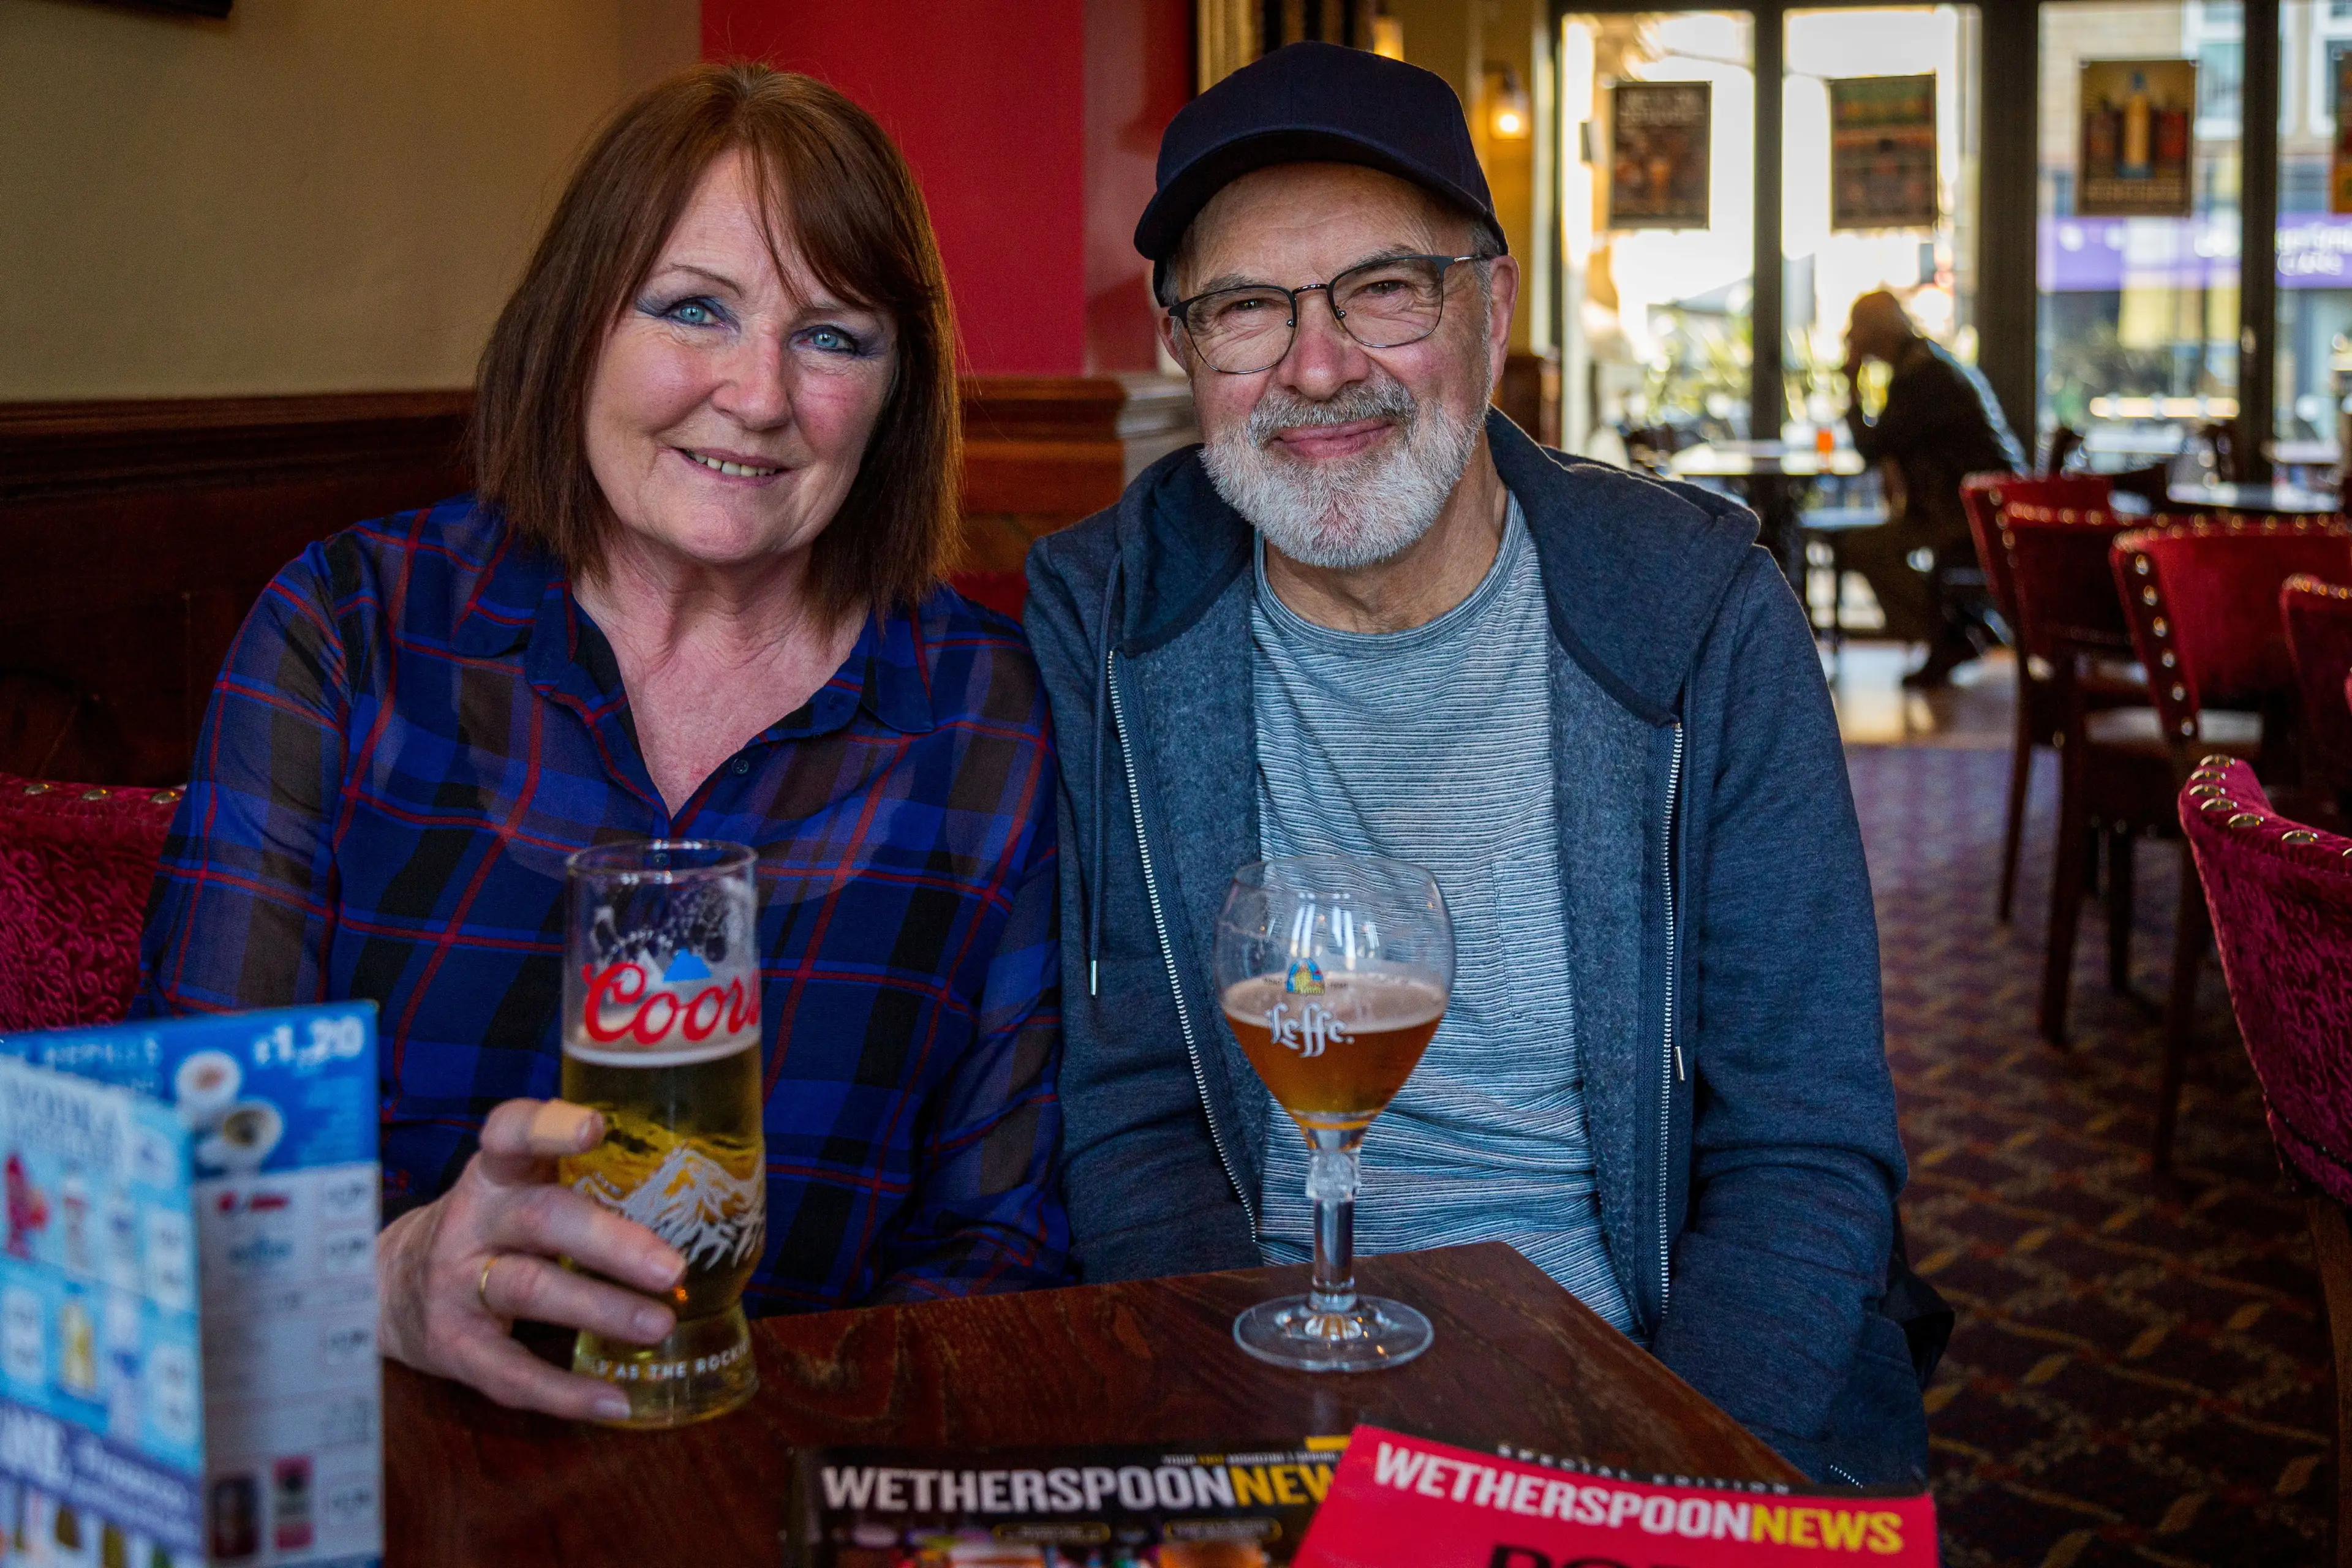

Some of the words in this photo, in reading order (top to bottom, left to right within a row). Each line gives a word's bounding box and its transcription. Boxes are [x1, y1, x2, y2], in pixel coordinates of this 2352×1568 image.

[648, 1361, 688, 1379] THE
[1497, 1444, 1630, 1482] SPECIAL
[1653, 1472, 1789, 1495] EDITION
